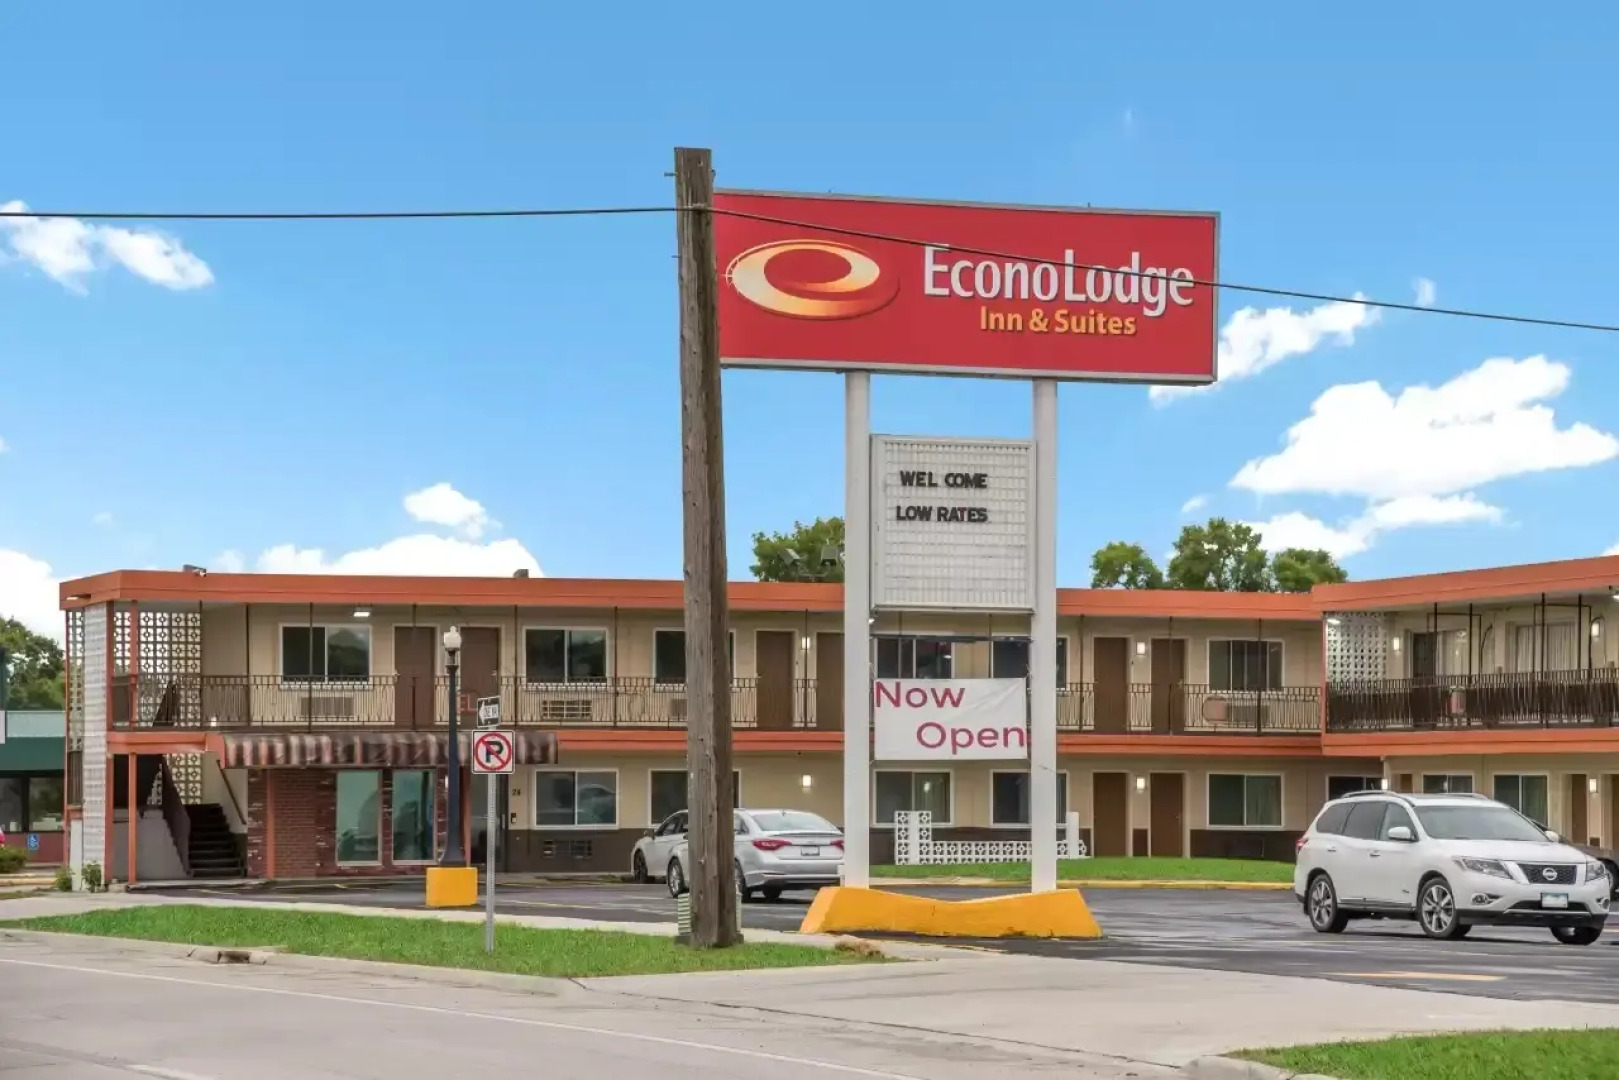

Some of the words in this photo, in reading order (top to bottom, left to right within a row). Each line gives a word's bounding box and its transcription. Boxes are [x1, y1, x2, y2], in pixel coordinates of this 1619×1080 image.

[980, 306, 1023, 332] Inn
[1029, 308, 1049, 333] &
[1054, 308, 1137, 335] Suites
[896, 505, 932, 521] LOW
[937, 506, 989, 523] RATES
[875, 681, 966, 708] Now
[916, 721, 1026, 755] Open
